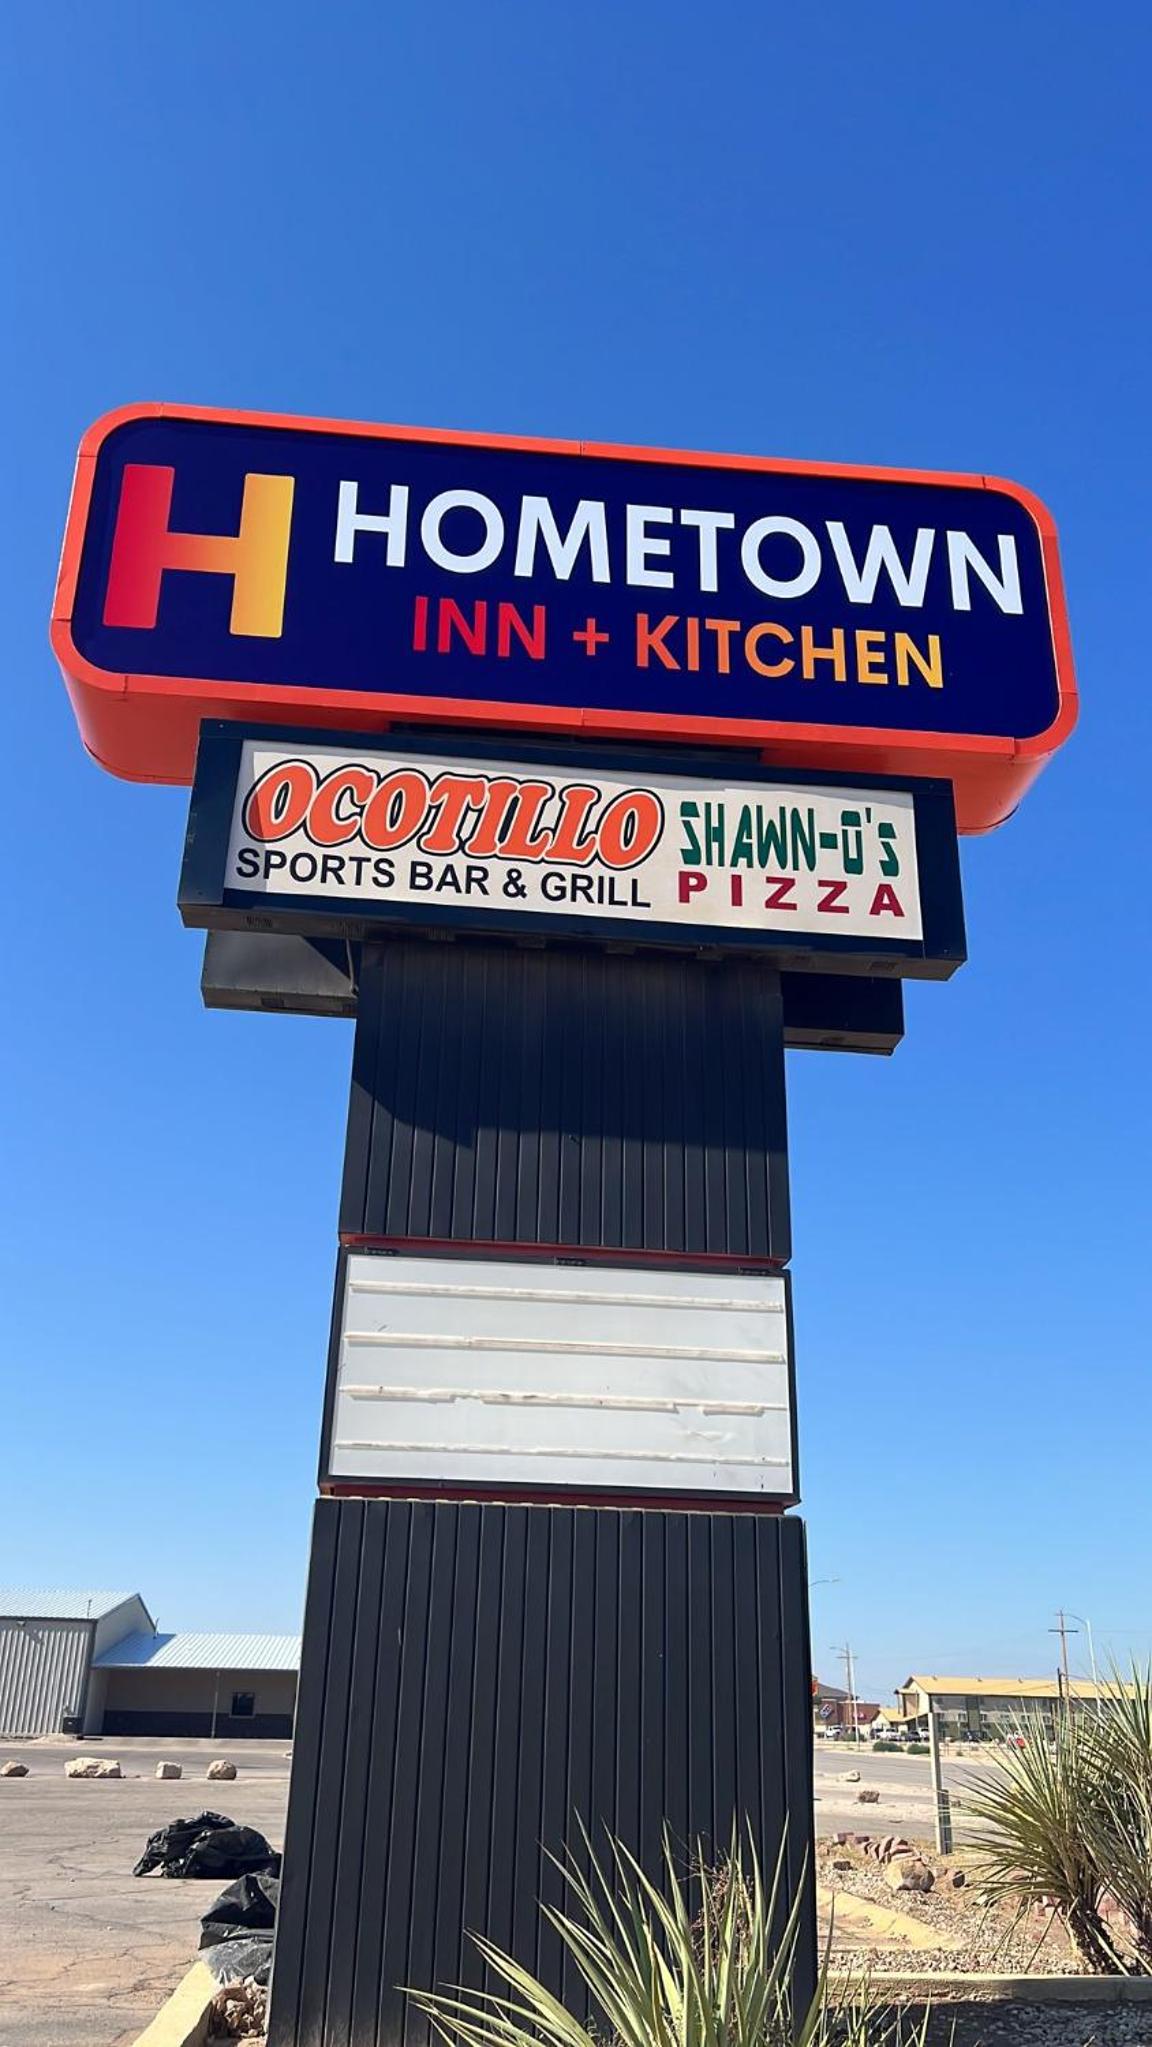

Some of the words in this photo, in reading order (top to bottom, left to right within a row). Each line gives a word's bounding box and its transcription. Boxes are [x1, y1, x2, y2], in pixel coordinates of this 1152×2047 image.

[103, 464, 295, 638] H
[334, 480, 1024, 615] HOMETOWN
[412, 596, 546, 660] INN
[573, 618, 609, 656] +
[635, 613, 944, 689] KITCHEN
[242, 759, 665, 870] OCOTILLO
[680, 801, 900, 877] SHAWN-O'S
[236, 847, 395, 888] SPORTS
[408, 861, 490, 895] BAR
[502, 868, 528, 899] &
[540, 871, 651, 908] GRILL
[678, 870, 905, 917] PIZZA
